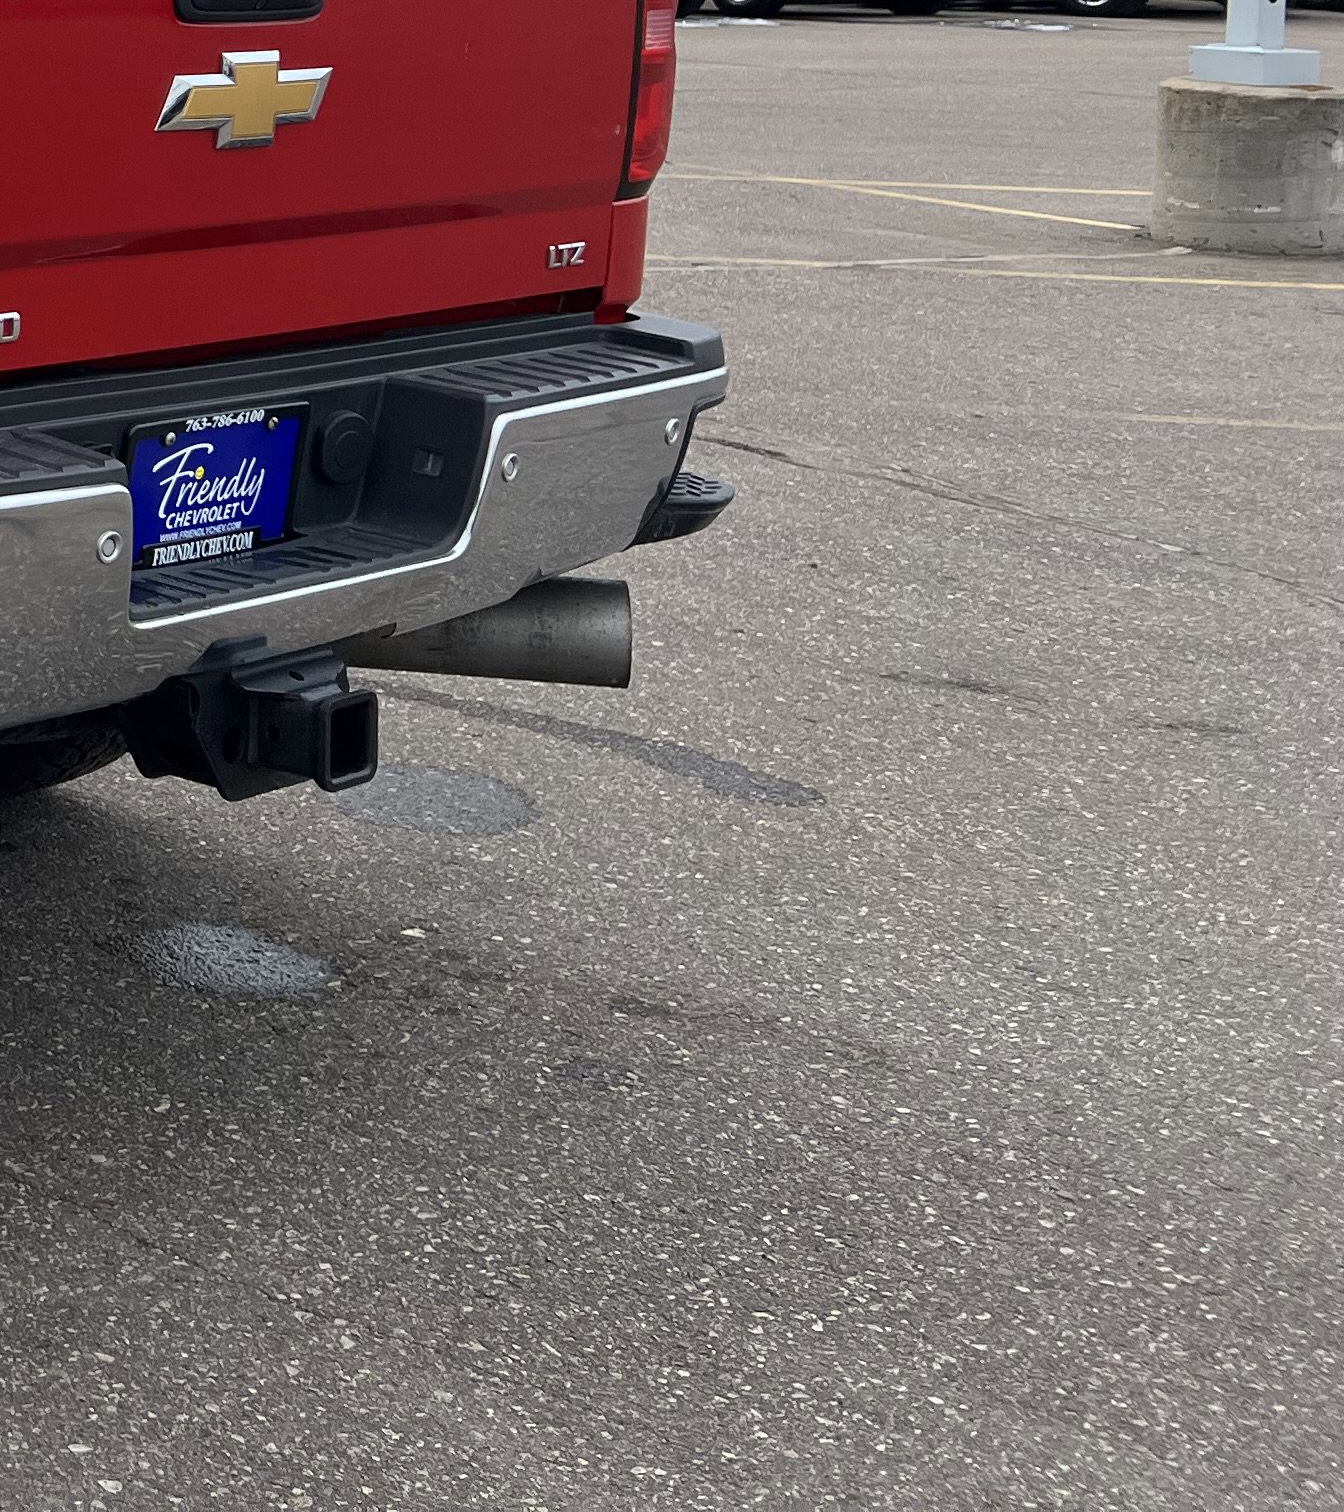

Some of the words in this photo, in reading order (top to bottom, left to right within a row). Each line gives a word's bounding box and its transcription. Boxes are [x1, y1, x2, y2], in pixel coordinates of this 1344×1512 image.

[548, 241, 587, 268] LTZ
[185, 409, 265, 432] 763-786-6100
[152, 443, 265, 518] Friendly
[165, 502, 240, 529] CHEVROLET
[152, 531, 254, 567] FRIENDLYCHEV.COM
